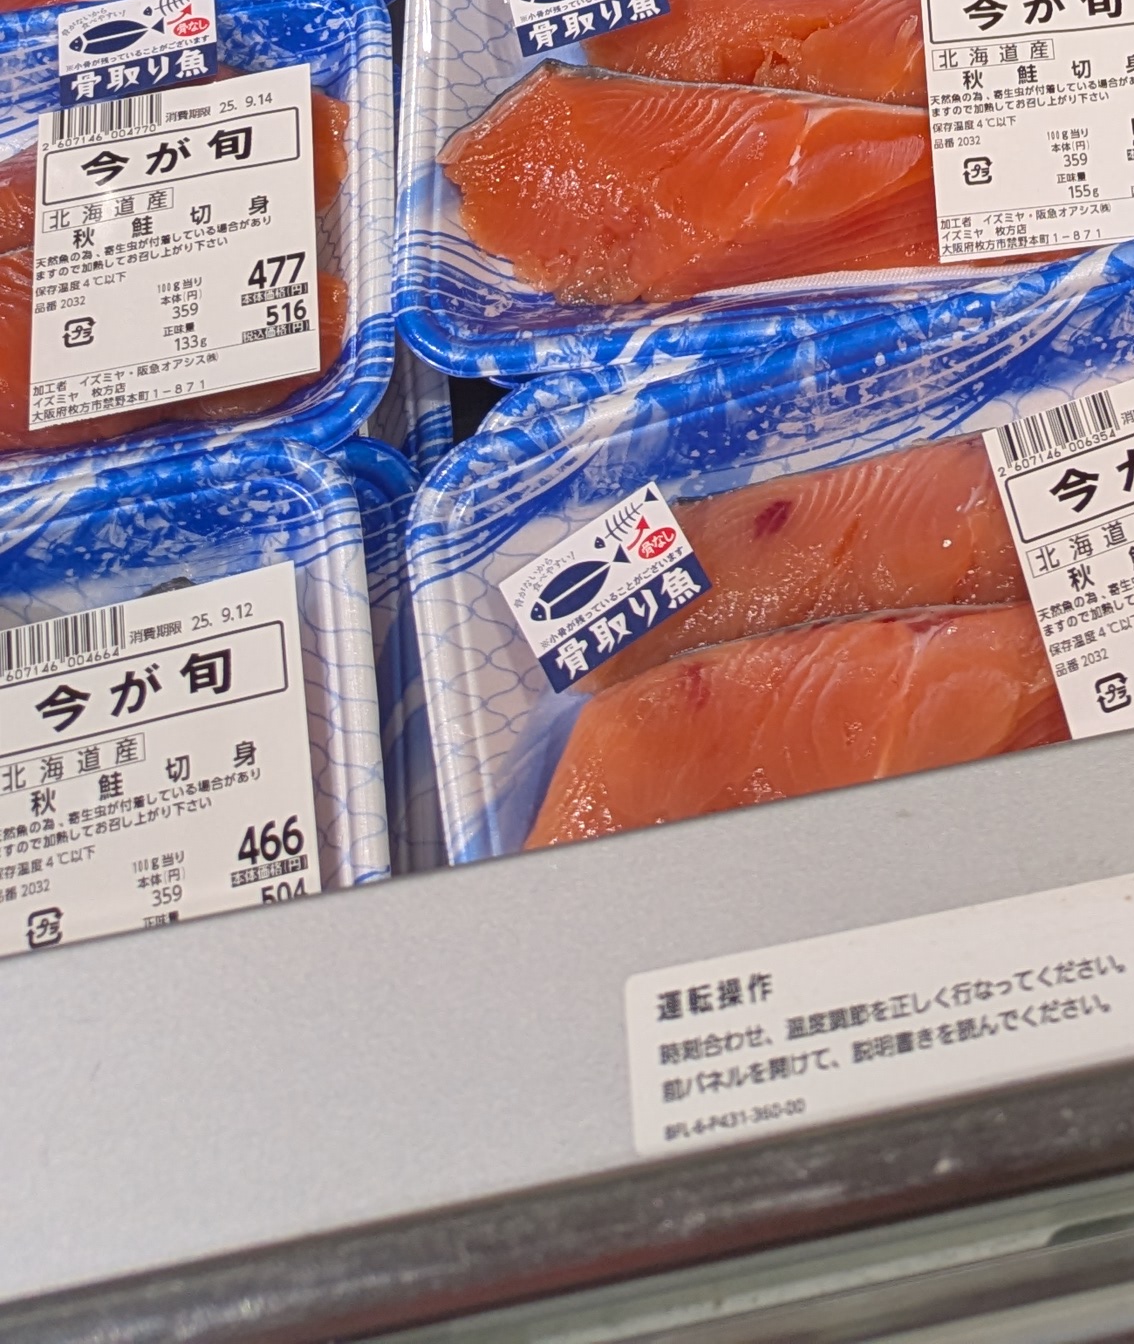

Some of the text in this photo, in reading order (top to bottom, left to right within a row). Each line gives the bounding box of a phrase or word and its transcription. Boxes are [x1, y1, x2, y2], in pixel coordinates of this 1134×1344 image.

[938, 40, 1049, 69] 北海道産
[81, 122, 253, 190] 今が旬
[1063, 153, 1088, 168] 359
[1068, 183, 1099, 200] 155g
[248, 251, 306, 291] 477
[265, 298, 306, 326] 516
[554, 568, 704, 684] 骨取り魚
[34, 642, 235, 739] 今が旬
[236, 814, 305, 869] 466
[656, 971, 773, 1023] 運転操作
